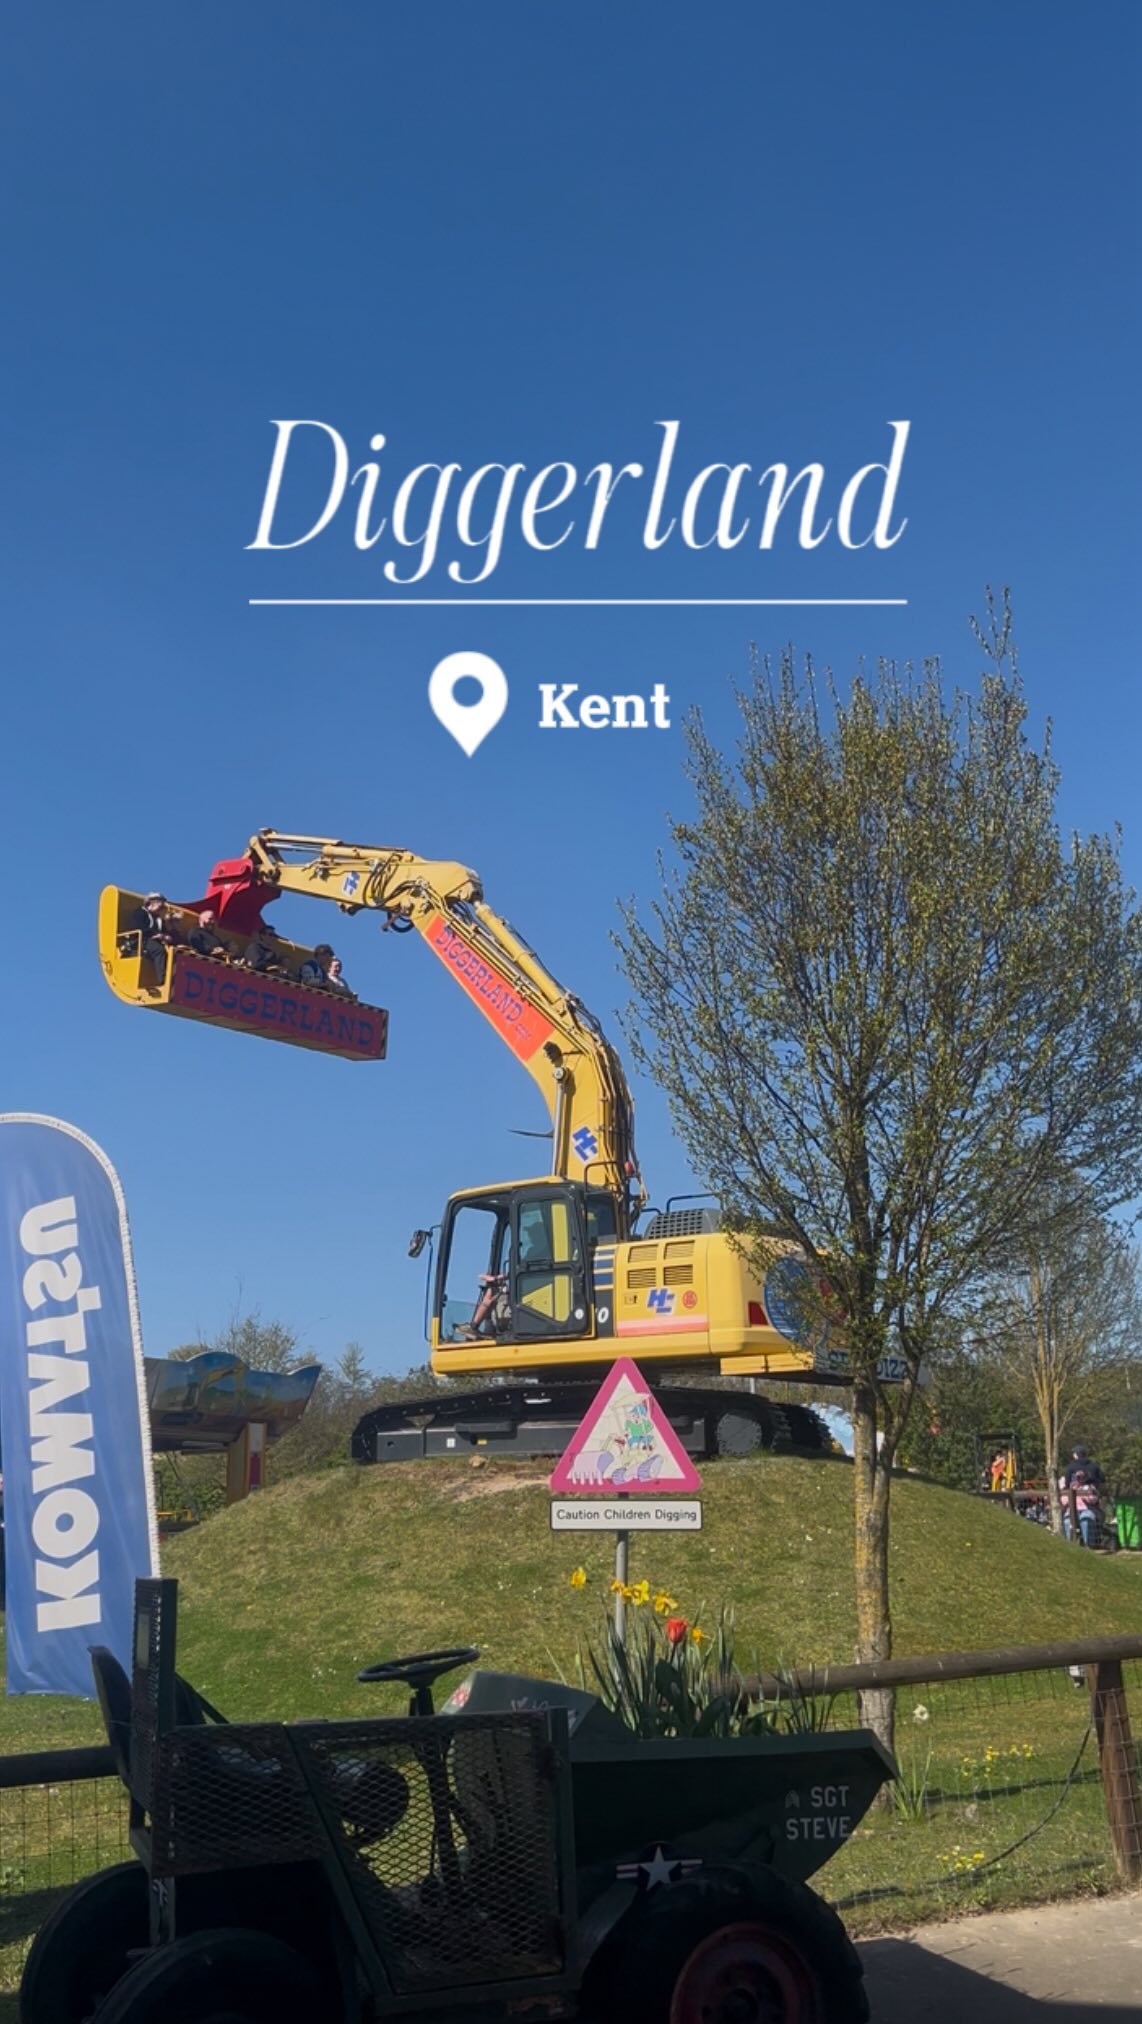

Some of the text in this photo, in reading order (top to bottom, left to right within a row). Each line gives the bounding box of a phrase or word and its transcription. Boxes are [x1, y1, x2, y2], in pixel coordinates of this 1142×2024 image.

[435, 925, 523, 1022] DIGGERLAND
[184, 971, 375, 1046] DIGGERLAND
[556, 1508, 697, 1522] Caution Children Digging
[811, 1785, 850, 1808] SGT
[786, 1816, 852, 1840] STEVE
